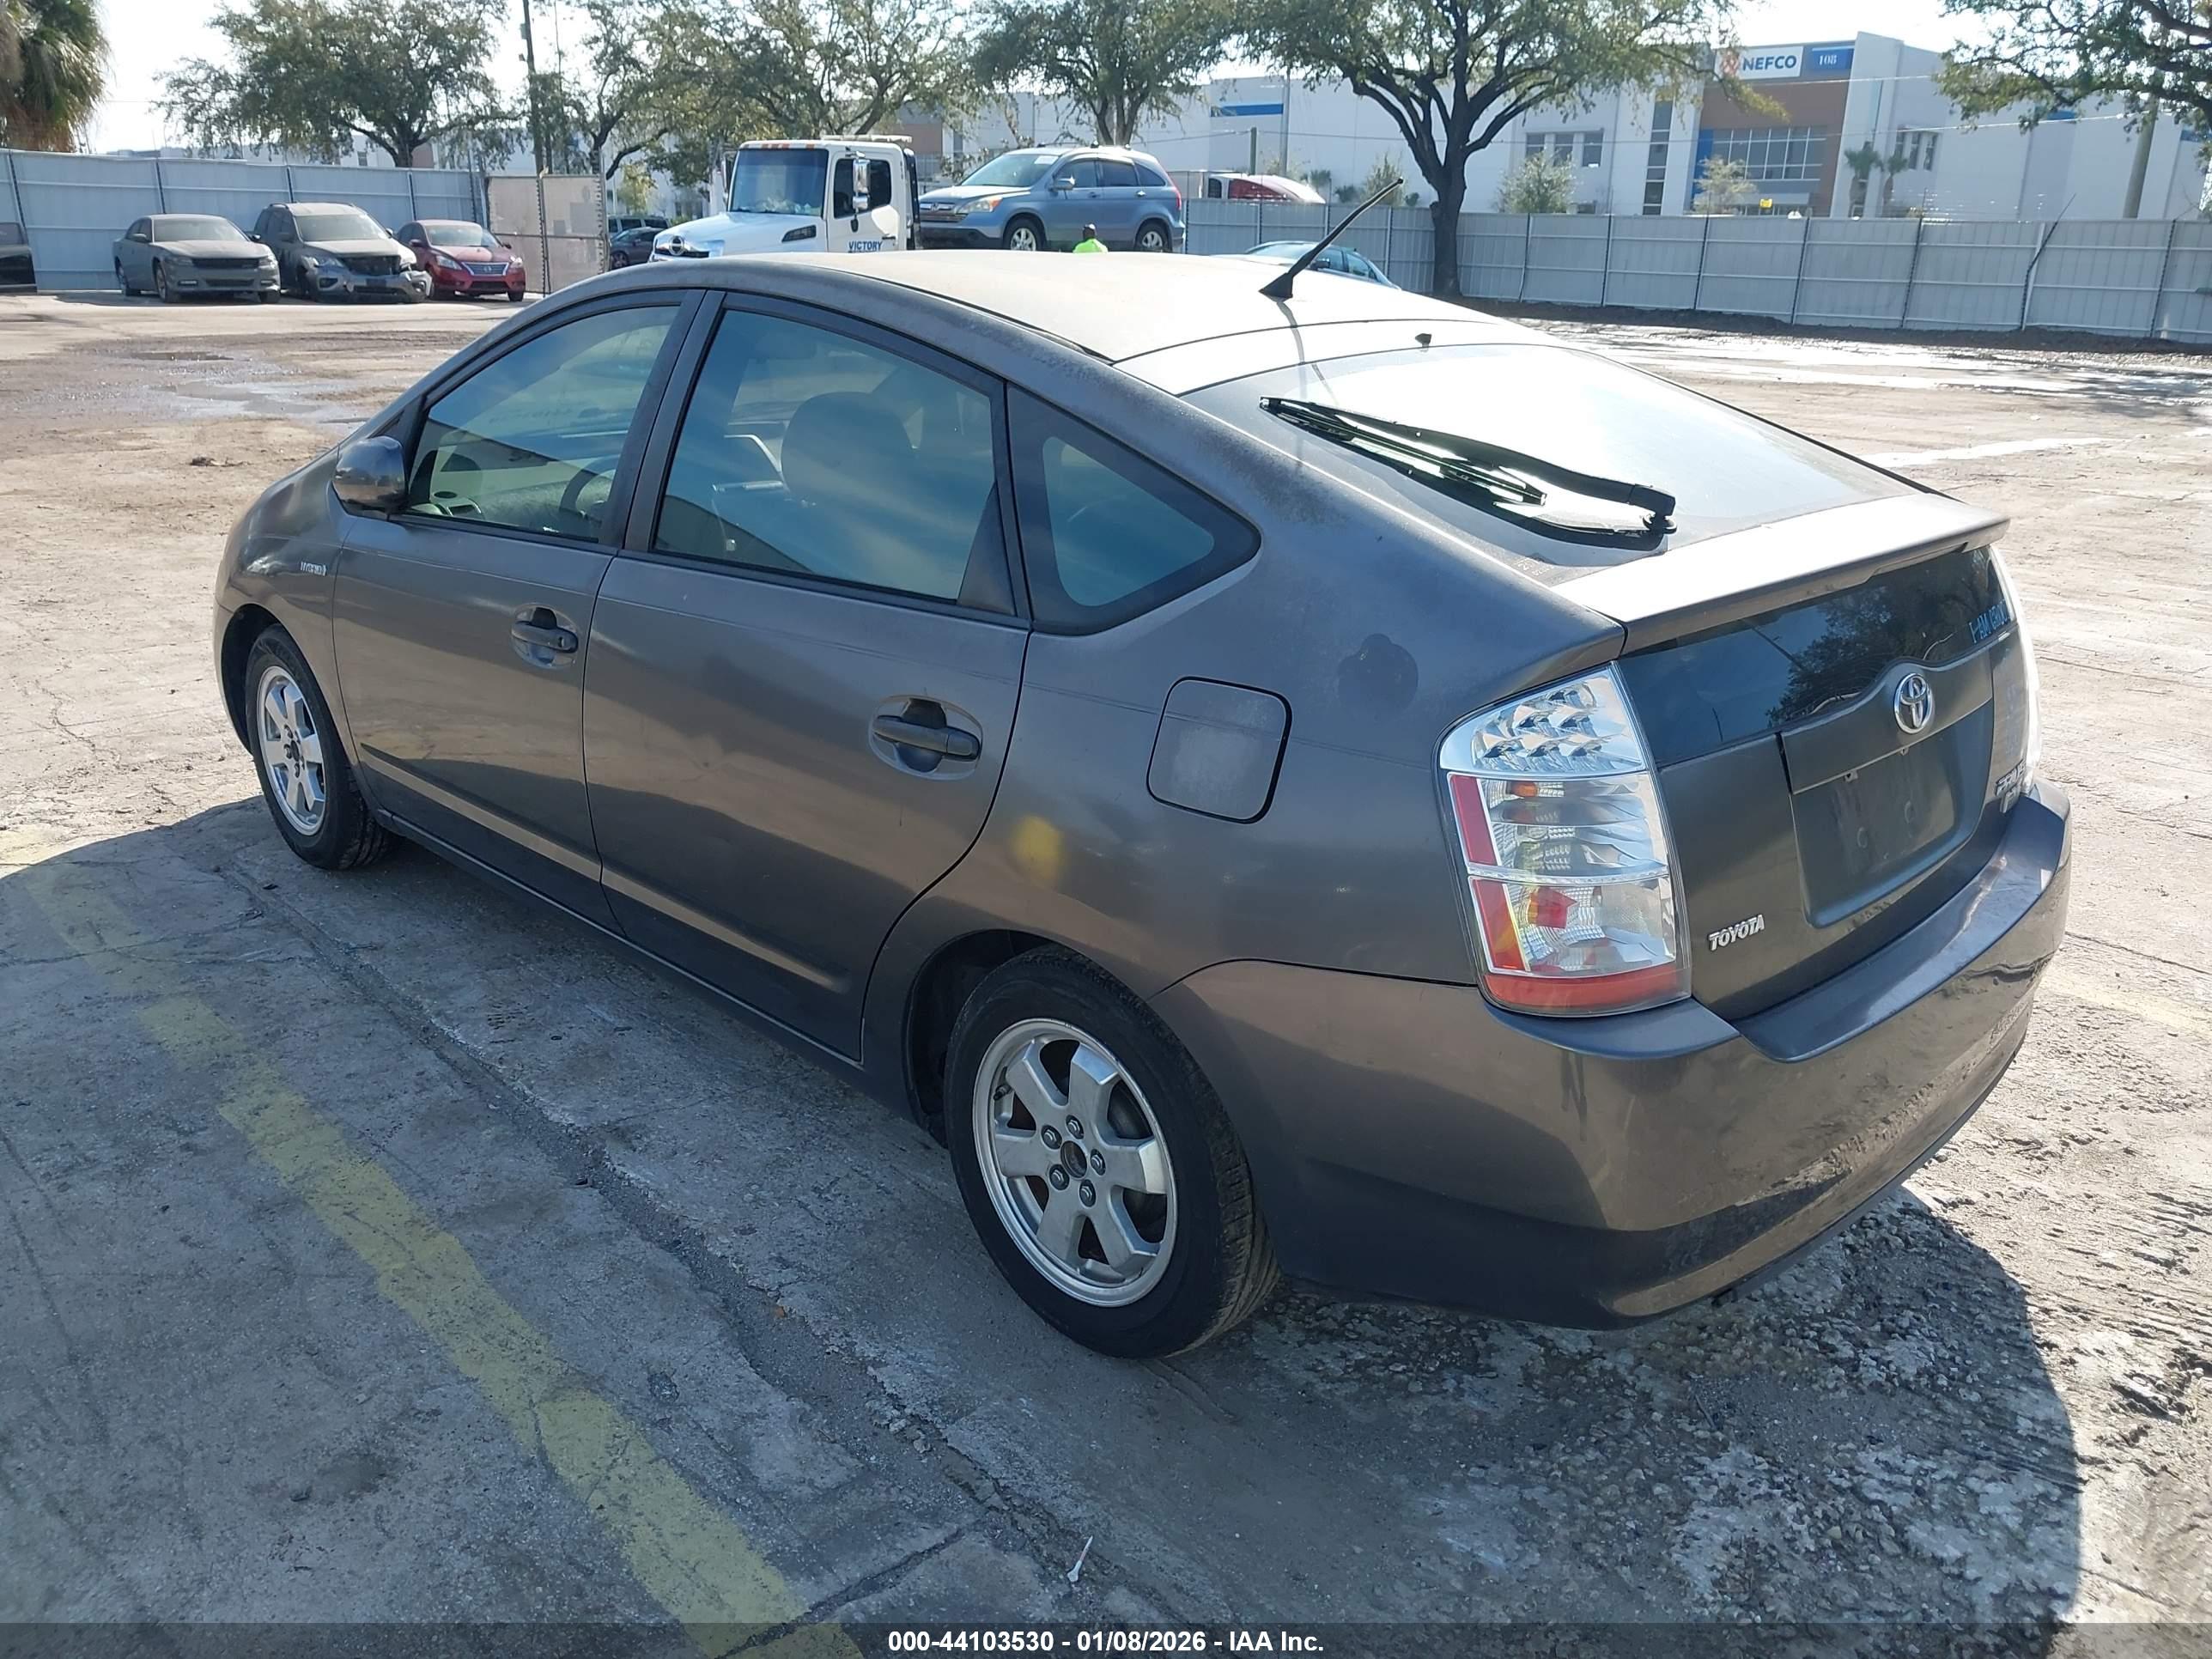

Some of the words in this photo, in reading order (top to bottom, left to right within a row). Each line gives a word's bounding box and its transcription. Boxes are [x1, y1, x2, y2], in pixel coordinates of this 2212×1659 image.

[1743, 55, 1796, 70] NEFCO
[848, 240, 883, 251] VICTORY
[1708, 914, 1765, 951] TOYOTA
